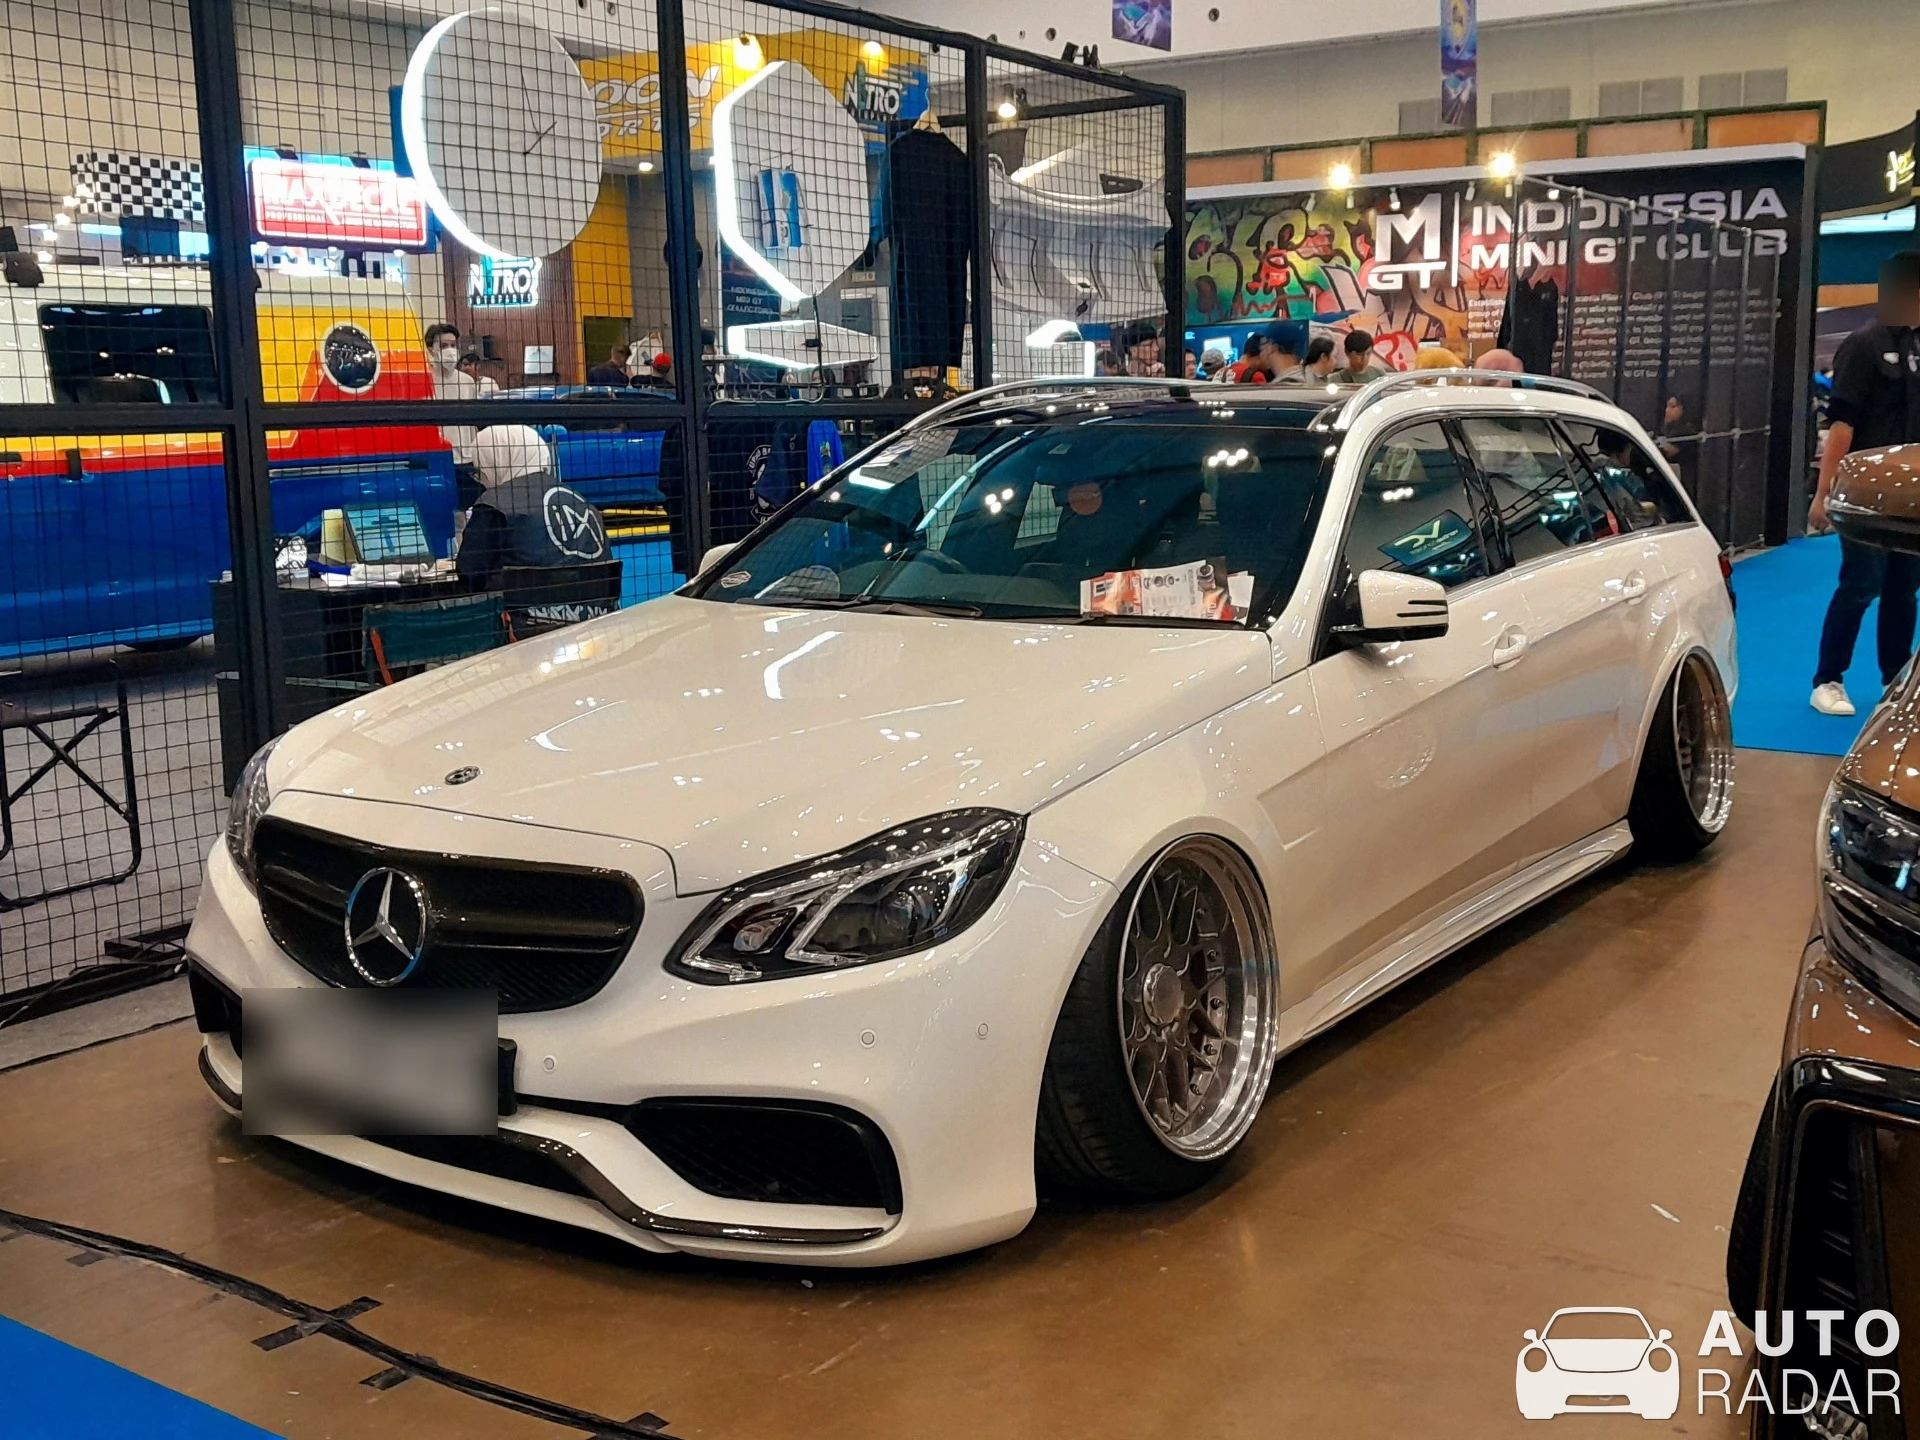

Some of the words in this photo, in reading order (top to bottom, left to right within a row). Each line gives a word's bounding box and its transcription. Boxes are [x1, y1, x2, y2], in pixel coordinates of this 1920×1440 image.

[1471, 187, 1789, 237] INDONESIA
[1471, 239, 1569, 270] MINI
[1656, 228, 1789, 262] CLUB
